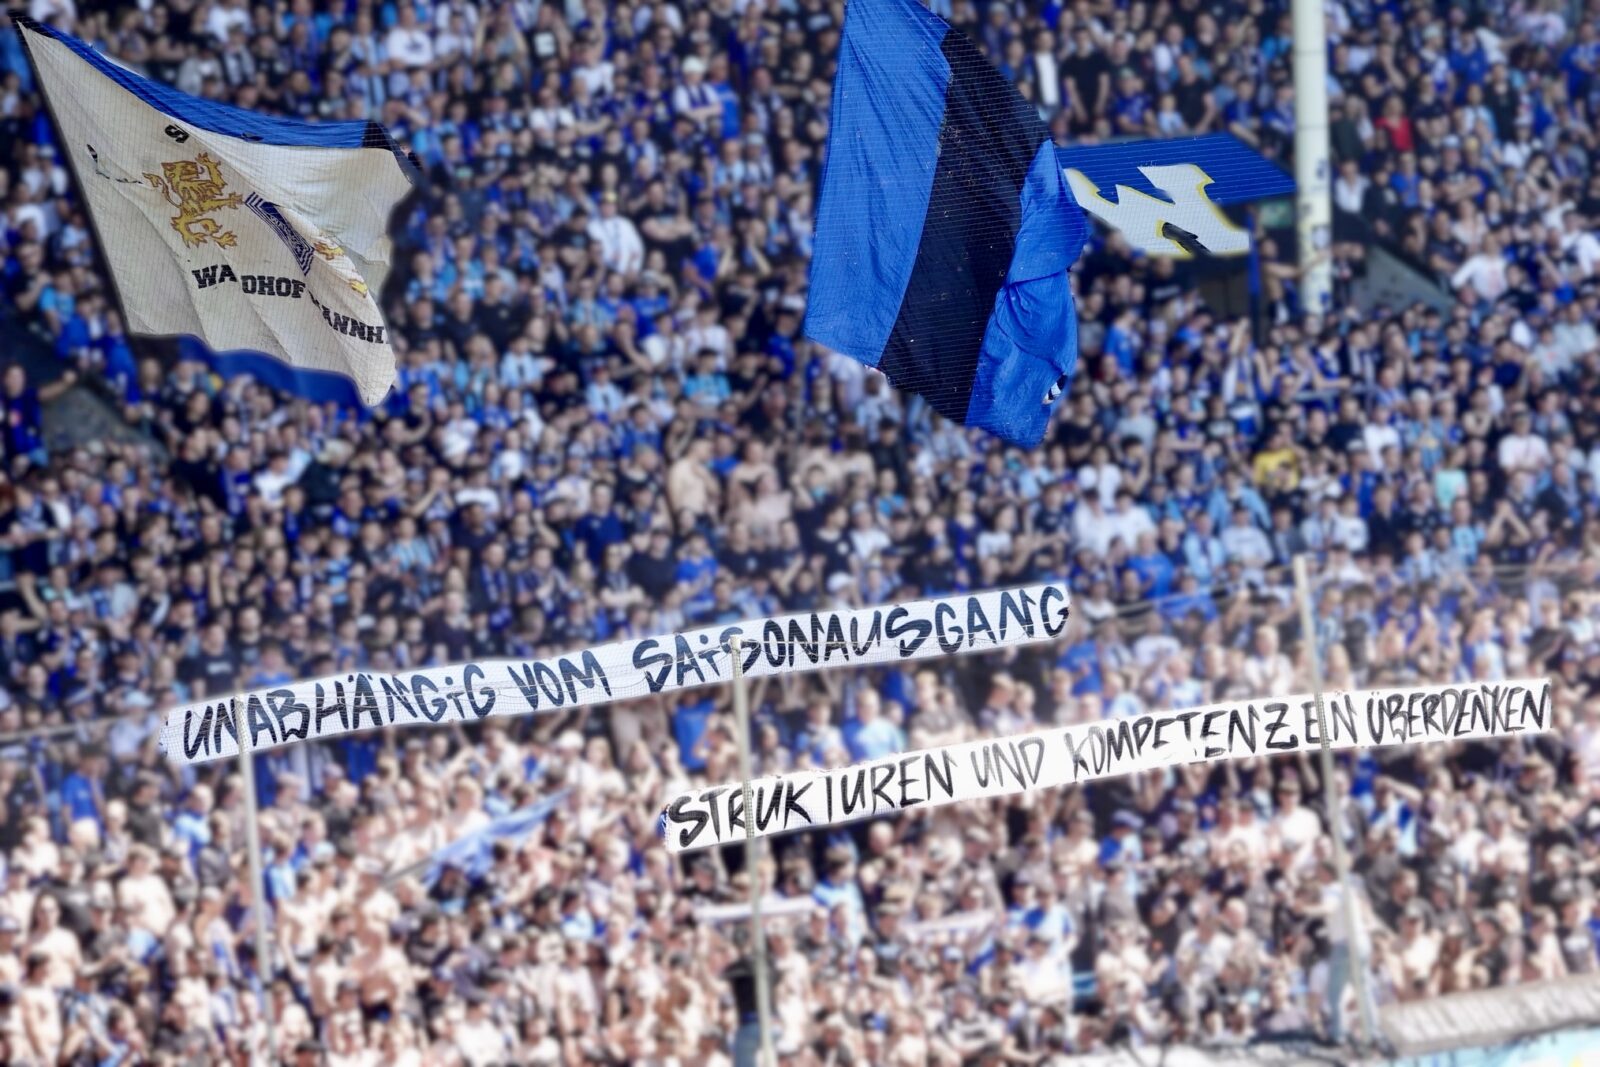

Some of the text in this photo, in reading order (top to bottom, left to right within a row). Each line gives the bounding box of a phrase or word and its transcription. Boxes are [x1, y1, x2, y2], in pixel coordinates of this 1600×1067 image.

[192, 264, 390, 344] WADHOF ANNH
[507, 650, 612, 711] VOM
[669, 749, 958, 847] STRUKTUREN
[970, 737, 1045, 790] UND
[1367, 683, 1551, 745] ÜBERDENKEN
